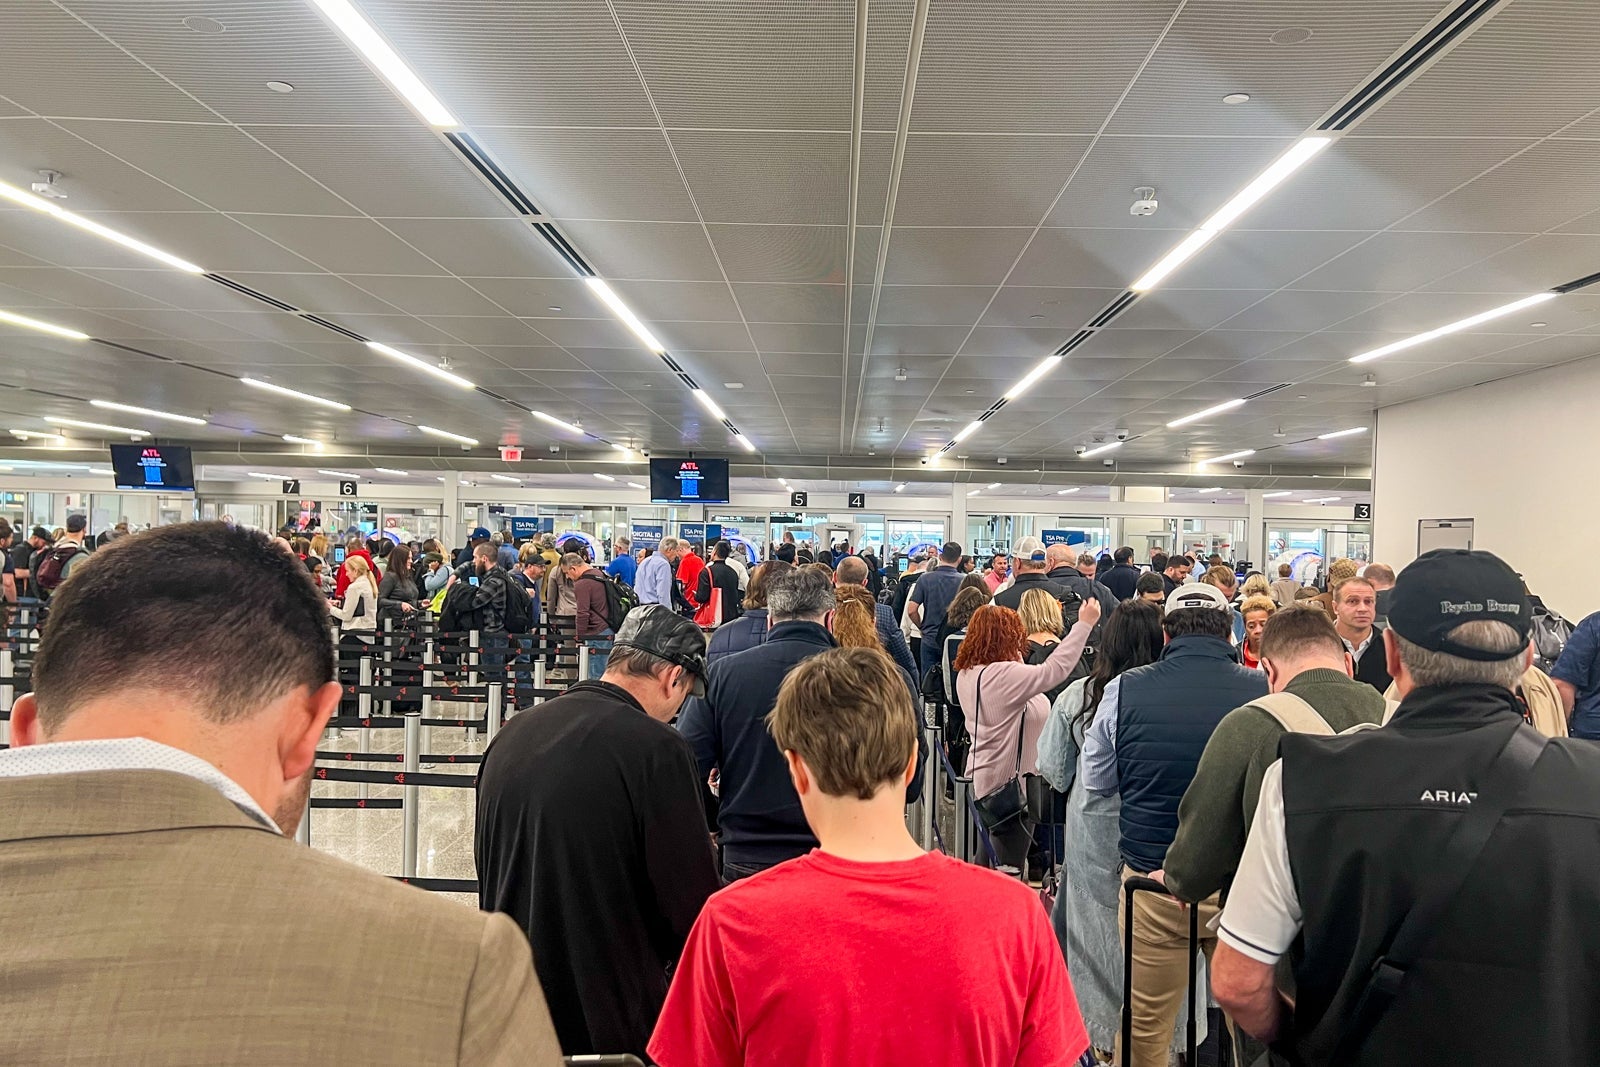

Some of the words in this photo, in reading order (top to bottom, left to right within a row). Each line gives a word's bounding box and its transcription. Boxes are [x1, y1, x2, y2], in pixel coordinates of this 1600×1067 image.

[142, 449, 160, 457] ATL
[680, 462, 699, 470] ATL
[286, 481, 295, 493] 7
[343, 482, 353, 494] 6
[794, 493, 804, 506] 5
[851, 495, 862, 507] 4
[1359, 505, 1369, 518] 3
